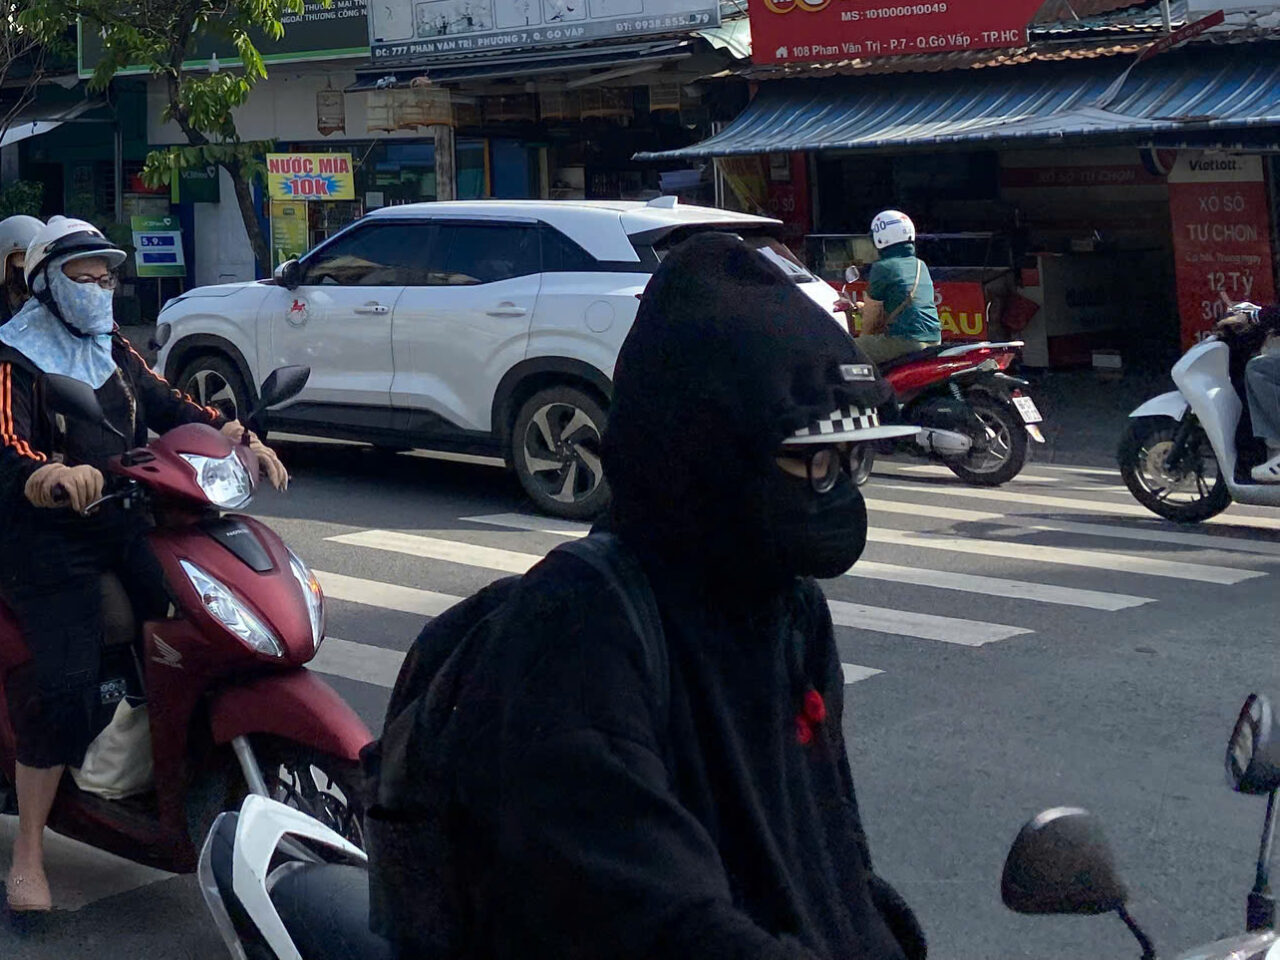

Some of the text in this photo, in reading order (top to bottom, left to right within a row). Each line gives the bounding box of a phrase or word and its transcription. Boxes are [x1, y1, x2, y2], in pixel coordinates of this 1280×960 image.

[392, 46, 408, 56] 777
[410, 43, 435, 54] PHAN
[793, 46, 810, 57] 108
[812, 44, 839, 56] Phan
[890, 38, 907, 50] P.7
[1207, 271, 1225, 292] 12
